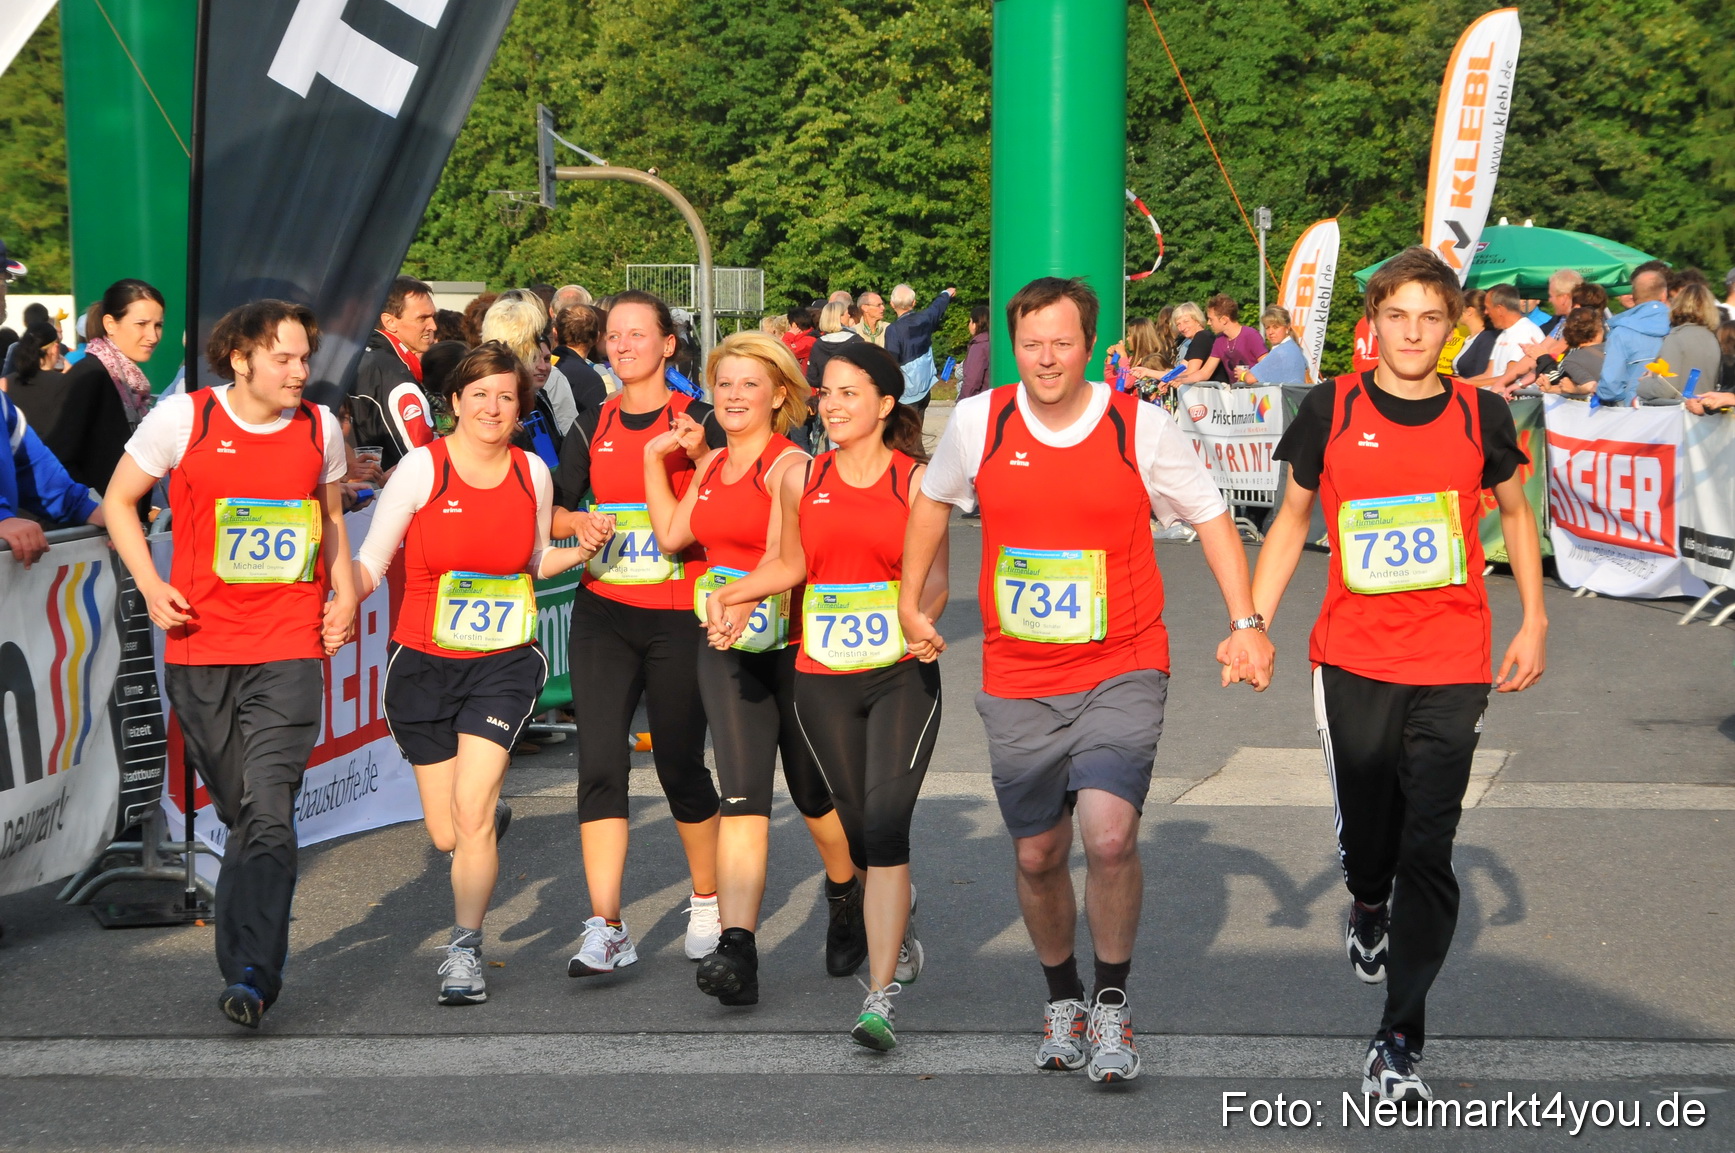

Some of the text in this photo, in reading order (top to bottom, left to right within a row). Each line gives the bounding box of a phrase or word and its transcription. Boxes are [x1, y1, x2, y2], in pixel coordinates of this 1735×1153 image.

[1450, 41, 1495, 209] KLEBL
[1489, 59, 1514, 175] www.klebl.de
[1312, 264, 1333, 365] www.klebl.de
[1211, 409, 1256, 425] Frischmann
[226, 527, 297, 561] 736
[1354, 527, 1438, 569] 738
[233, 562, 265, 570] Michael
[608, 564, 628, 574] Katja
[1369, 568, 1410, 579] Andreas
[1005, 579, 1081, 619] 734
[448, 599, 515, 633] 737
[1022, 618, 1041, 629] Ingo
[453, 632, 483, 641] Kerstin
[815, 612, 889, 648] 739
[828, 649, 868, 659] Christina
[486, 715, 510, 731] JAKO
